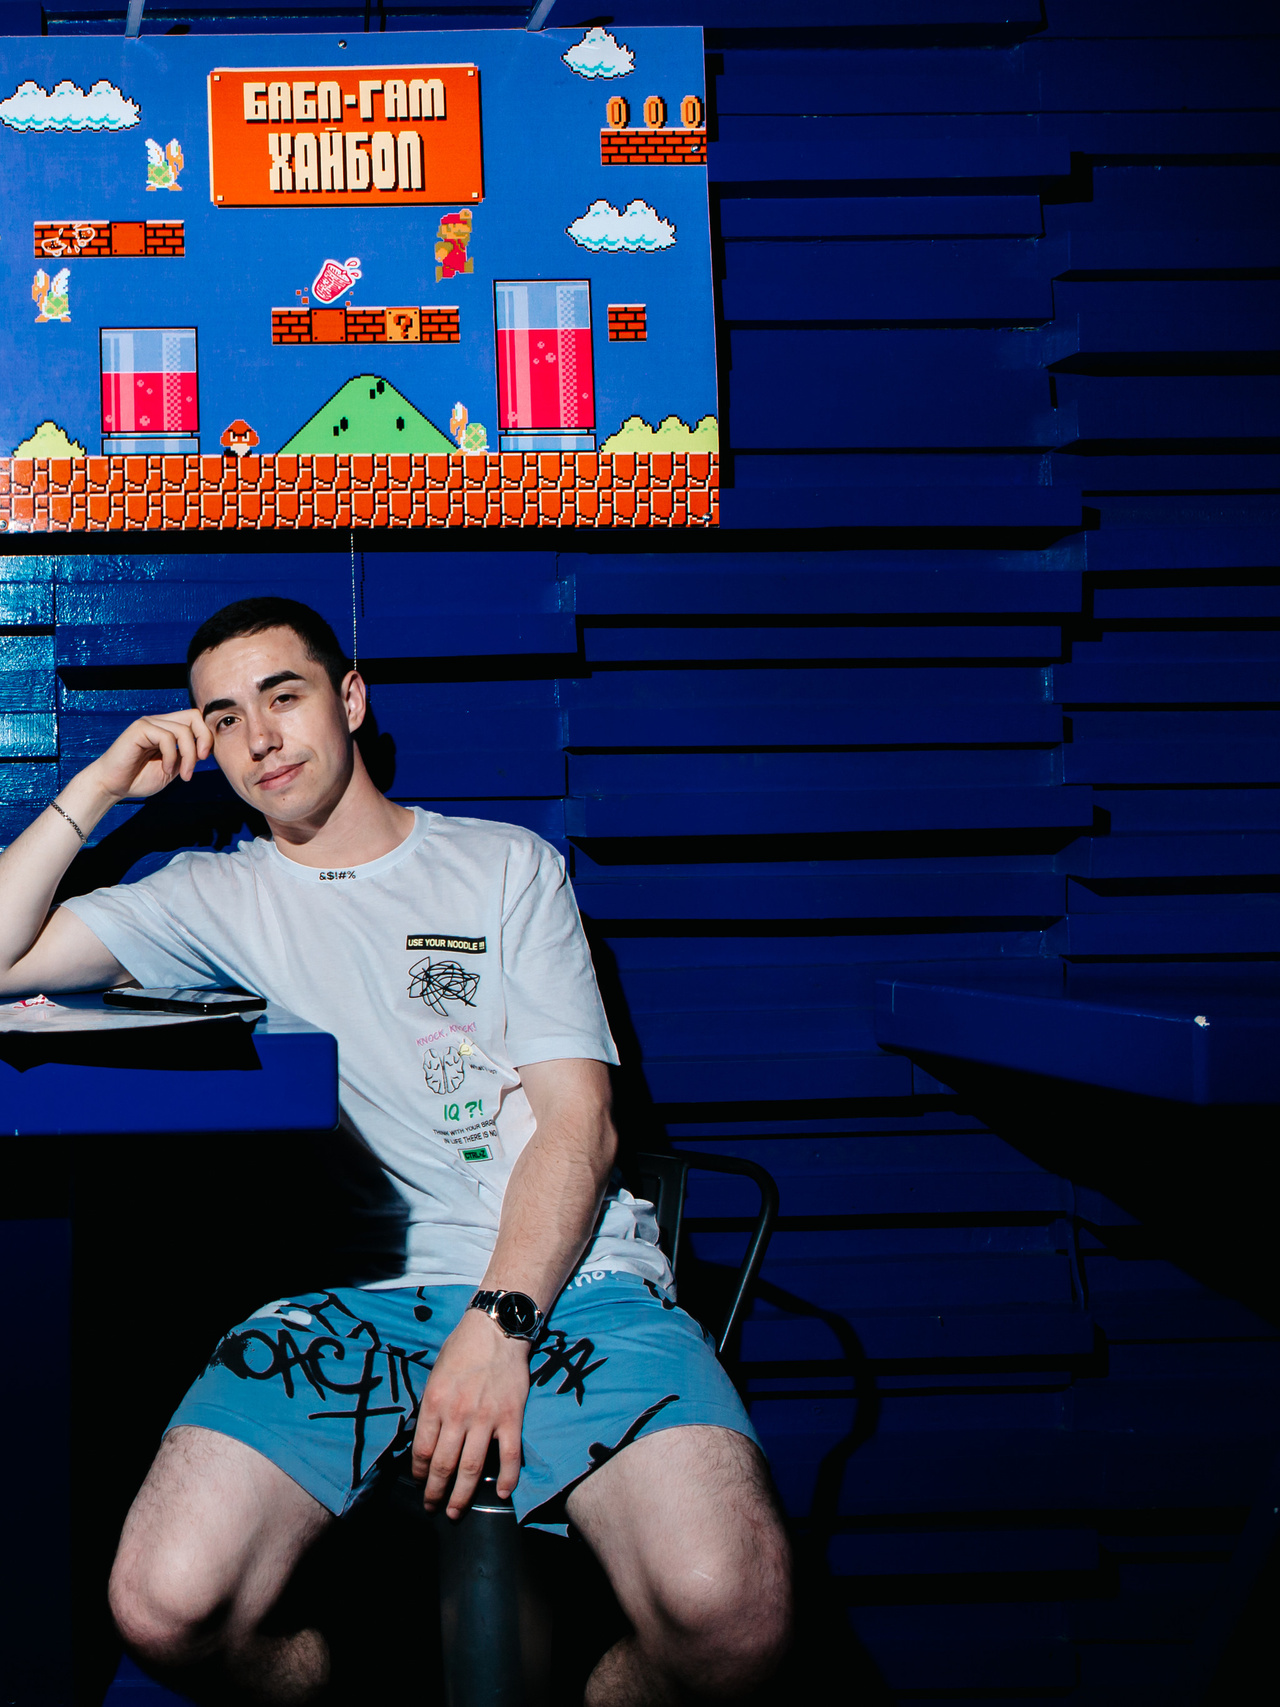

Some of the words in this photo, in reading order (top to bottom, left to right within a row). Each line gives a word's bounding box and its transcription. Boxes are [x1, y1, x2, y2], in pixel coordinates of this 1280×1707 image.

[243, 78, 447, 123] БАБЛ-ГАМ
[268, 127, 425, 192] ХАЙБОЛ
[408, 938, 424, 947] USE
[425, 938, 446, 948] YOUR
[447, 939, 478, 950] NOODLE
[444, 1103, 460, 1121] IQ
[464, 1099, 483, 1119] ?!
[449, 1128, 465, 1137] WITH
[465, 1123, 481, 1133] YOUR
[450, 1137, 463, 1145] LIFE
[463, 1132, 483, 1144] THERE
[483, 1130, 489, 1139] IS
